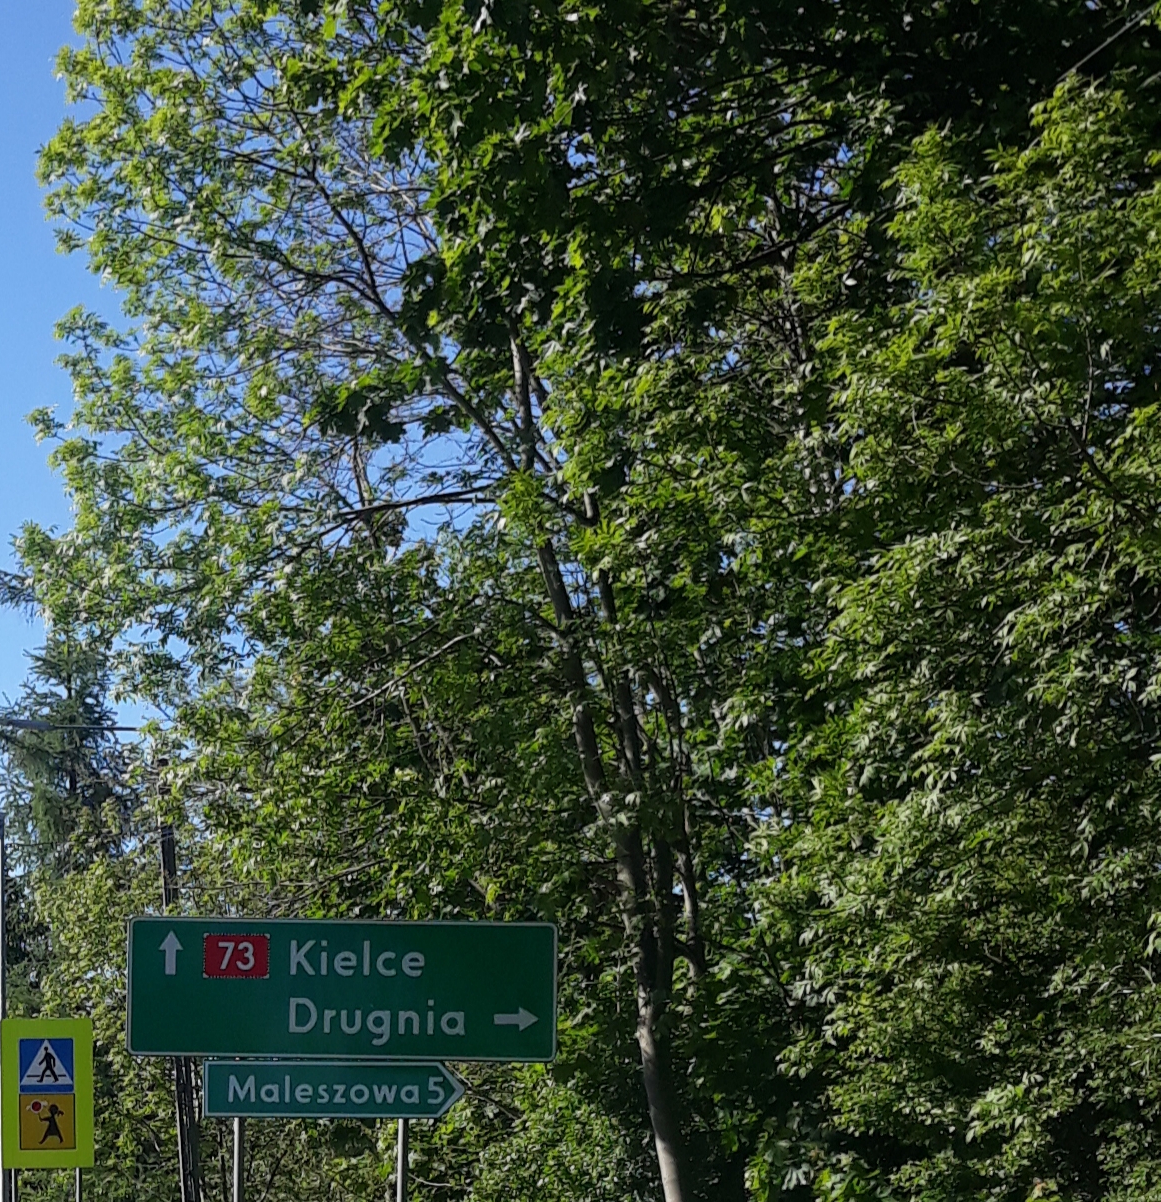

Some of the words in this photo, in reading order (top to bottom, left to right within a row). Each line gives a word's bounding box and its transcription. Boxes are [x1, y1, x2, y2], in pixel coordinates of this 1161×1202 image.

[218, 941, 255, 971] 73
[289, 939, 426, 977] Kielce
[288, 997, 466, 1046] Drugnia
[227, 1075, 421, 1105] Maleszowa
[427, 1076, 445, 1105] 5
